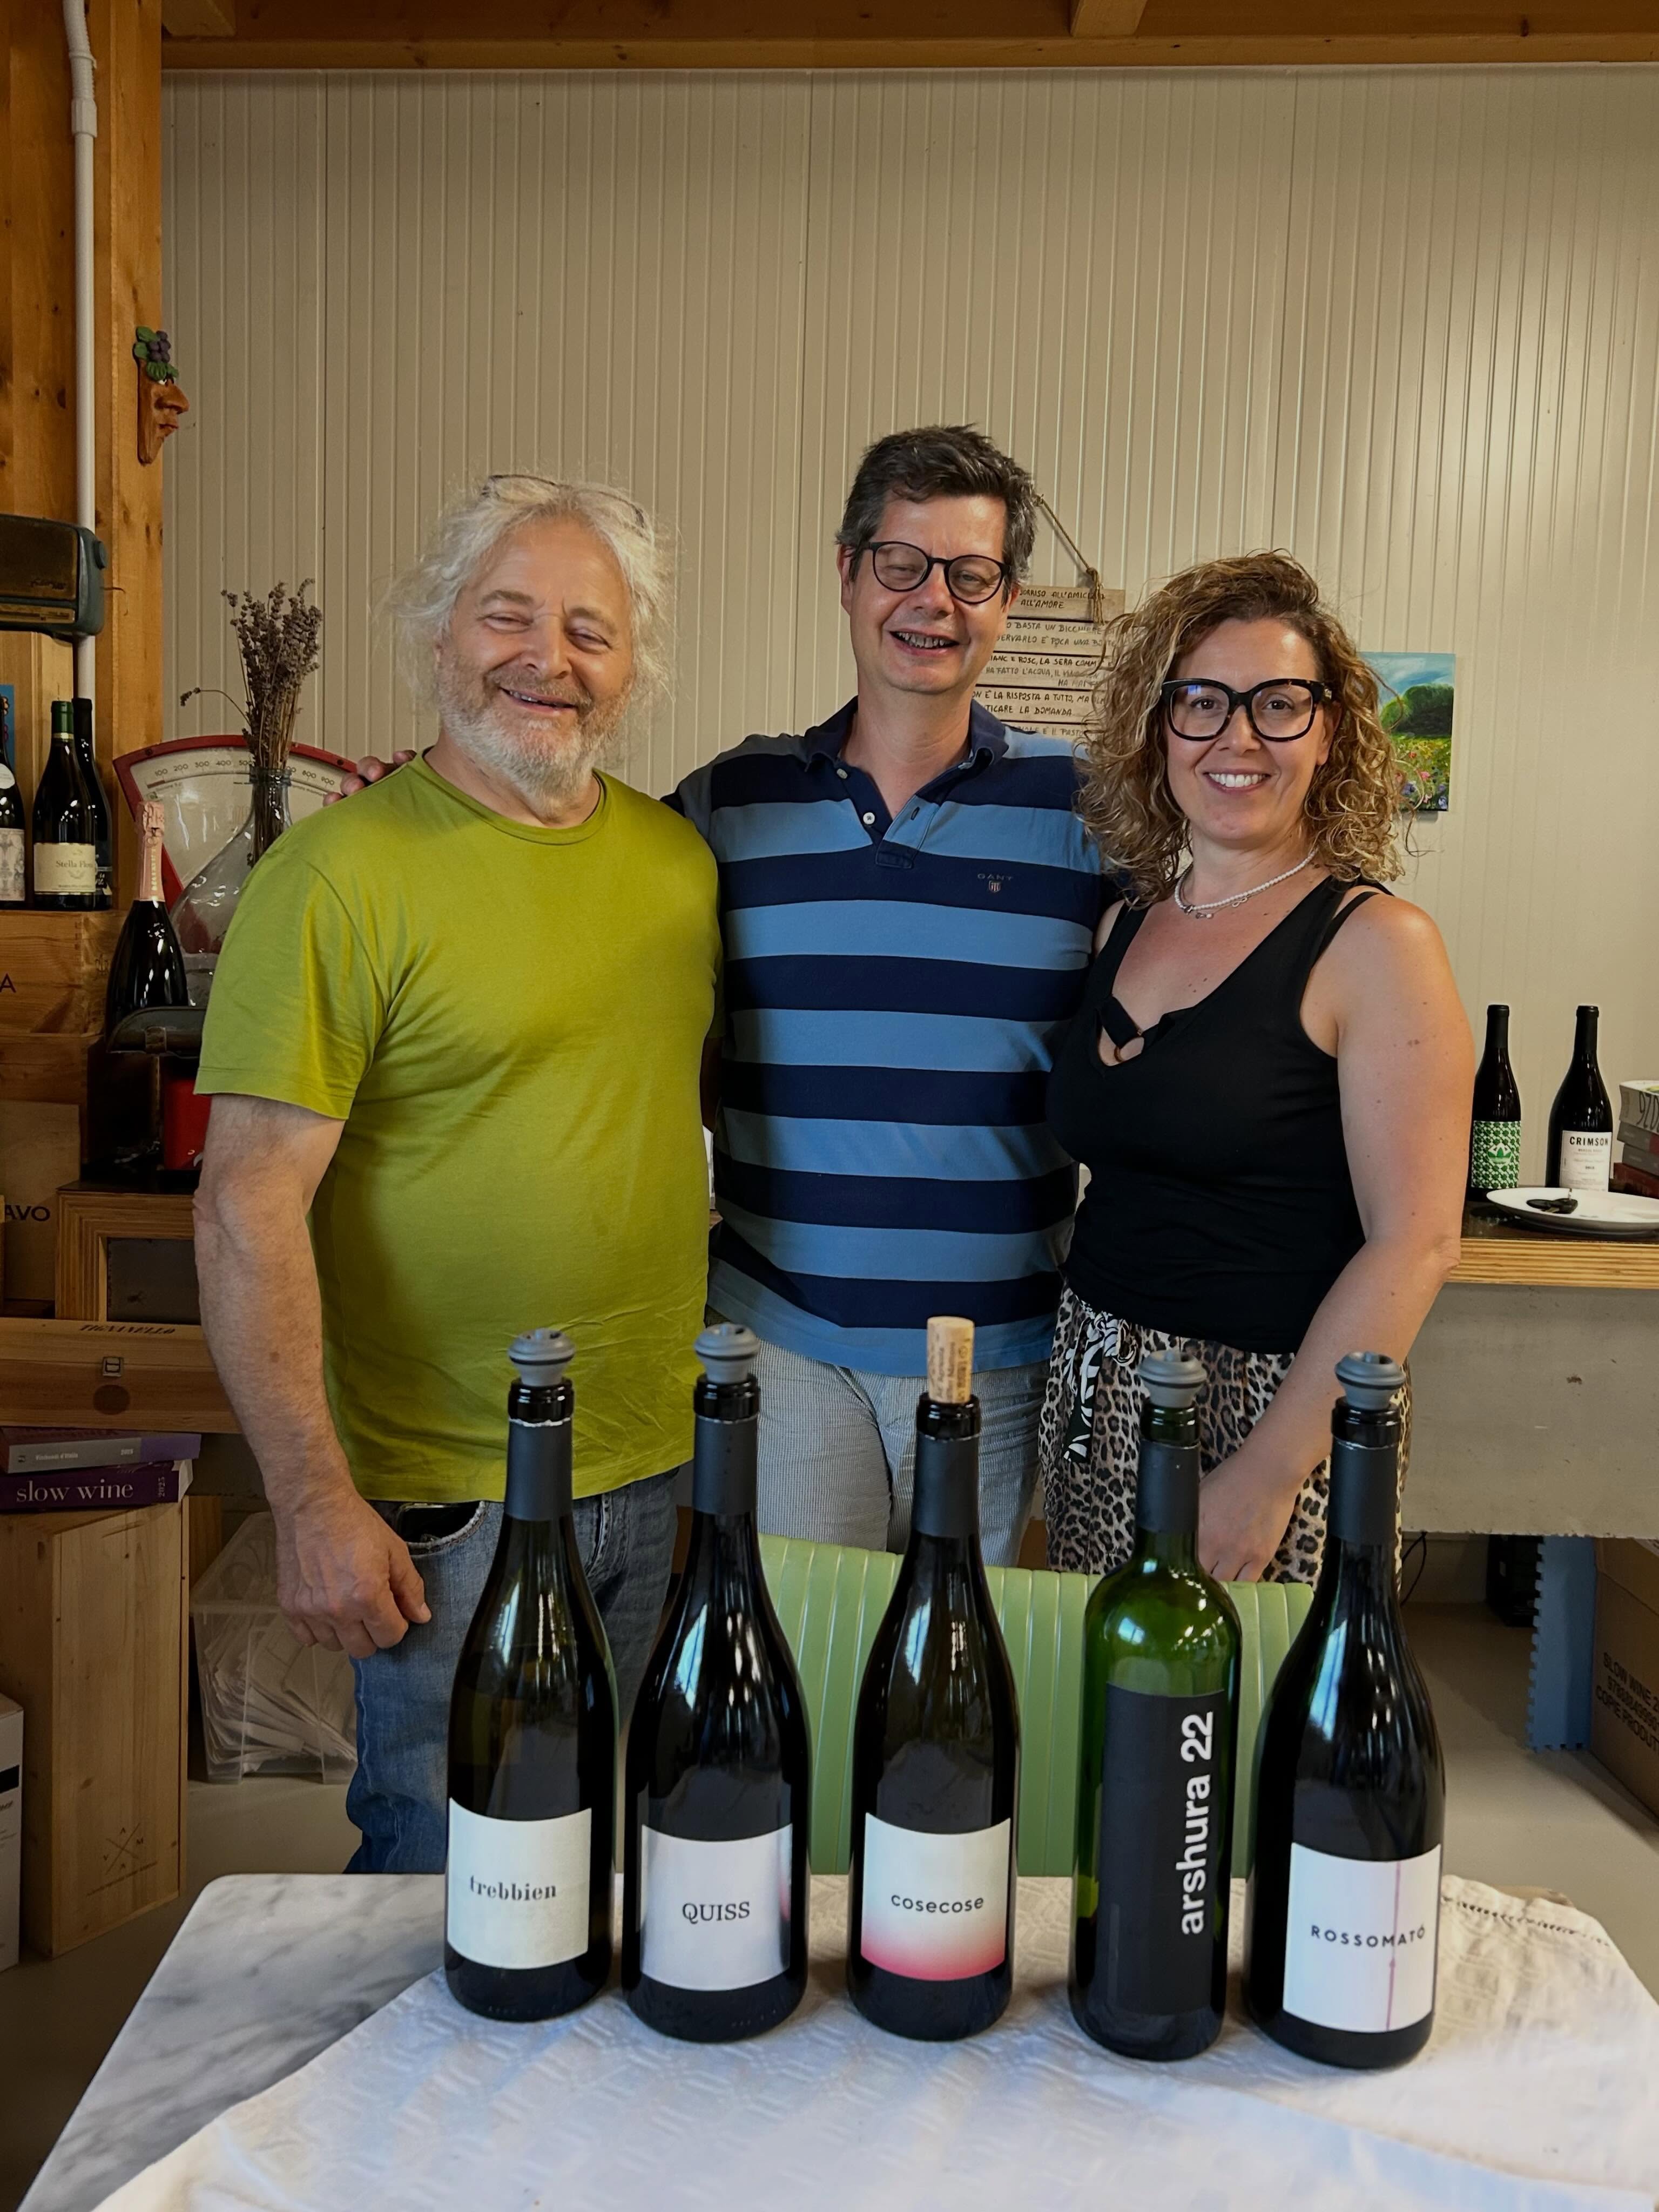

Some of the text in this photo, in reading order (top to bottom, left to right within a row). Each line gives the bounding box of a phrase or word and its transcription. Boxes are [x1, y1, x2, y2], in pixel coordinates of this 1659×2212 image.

[1020, 599, 1064, 609] ALL'AMORE
[1015, 622, 1041, 630] BASTA
[1054, 658, 1073, 666] SERA
[1058, 679, 1068, 687] HA
[994, 691, 1003, 699] LA
[1006, 692, 1041, 700] RISPOSTA
[1076, 695, 1089, 703] MA
[1034, 707, 1072, 716] DOMANDA
[154, 768, 168, 777] 100
[173, 764, 189, 772] 200
[302, 770, 316, 779] 800
[321, 777, 335, 786] 900
[56, 859, 77, 868] Stella
[977, 873, 1014, 881] GANT
[1569, 1136, 1608, 1147] CRIMSON
[16, 1478, 134, 1503] slow wine
[1603, 1652, 1627, 1684] SLOW
[1628, 1674, 1651, 1706] WINE
[1596, 1685, 1621, 1718] COPIE
[1176, 1711, 1213, 1936] arshura 22
[469, 1874, 558, 1902] trebbien
[891, 1894, 984, 1914] cosecose
[682, 1900, 751, 1925] QUISS
